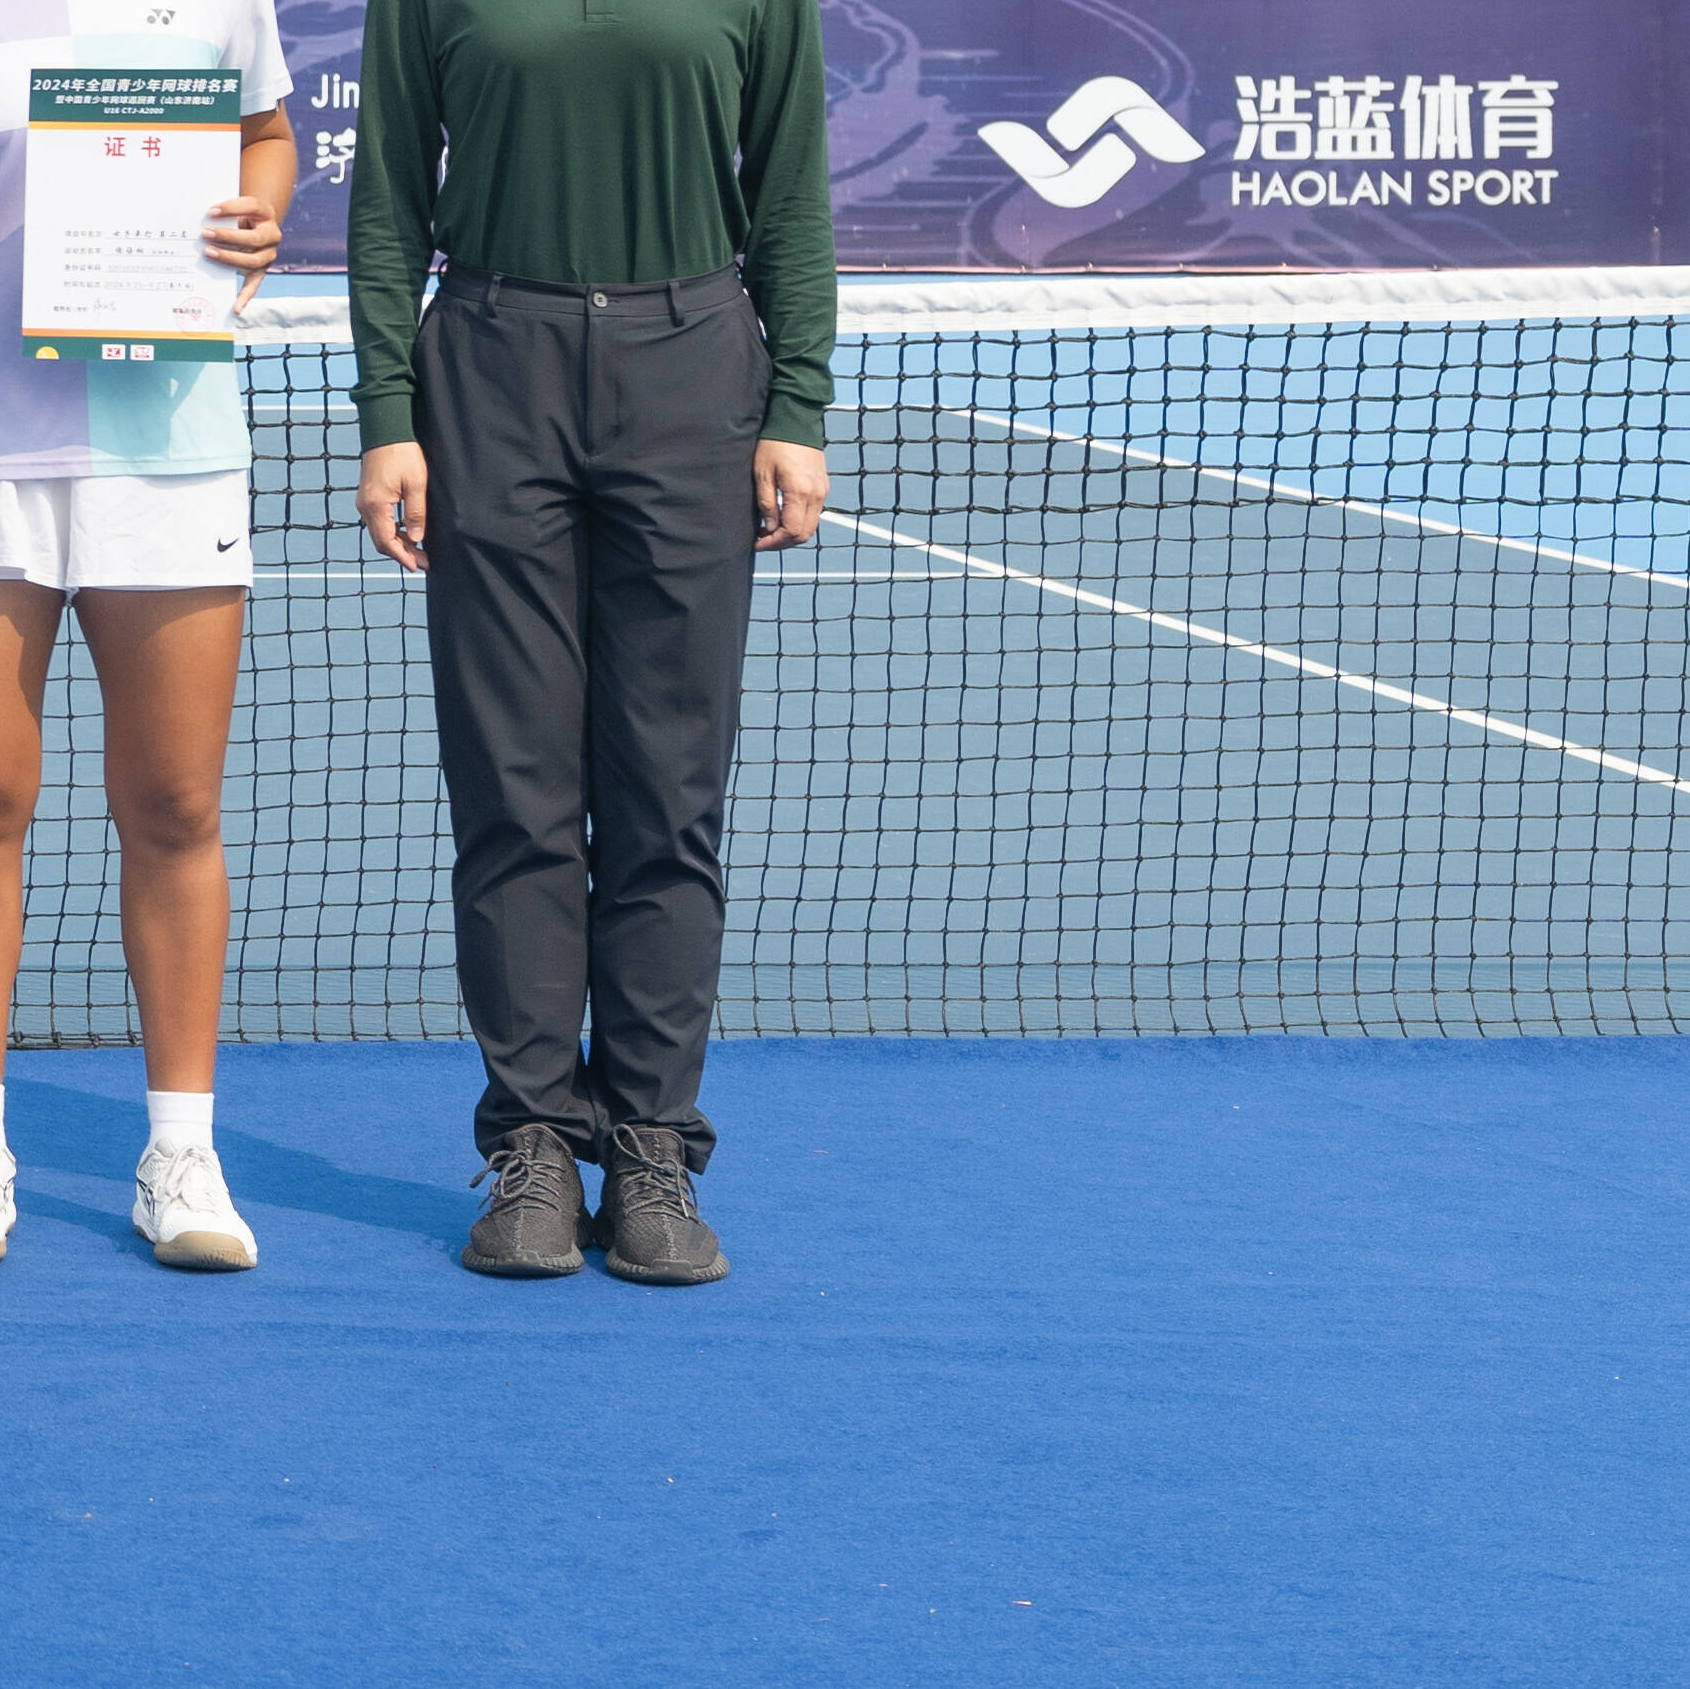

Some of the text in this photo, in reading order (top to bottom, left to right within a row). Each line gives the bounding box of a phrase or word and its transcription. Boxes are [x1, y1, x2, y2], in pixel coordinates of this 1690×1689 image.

[32, 78, 239, 93] 2024年全国青少年网球排名赛
[1232, 74, 1560, 161] 浩蓝体育
[1231, 169, 1560, 207] HAOLAN SPORT
